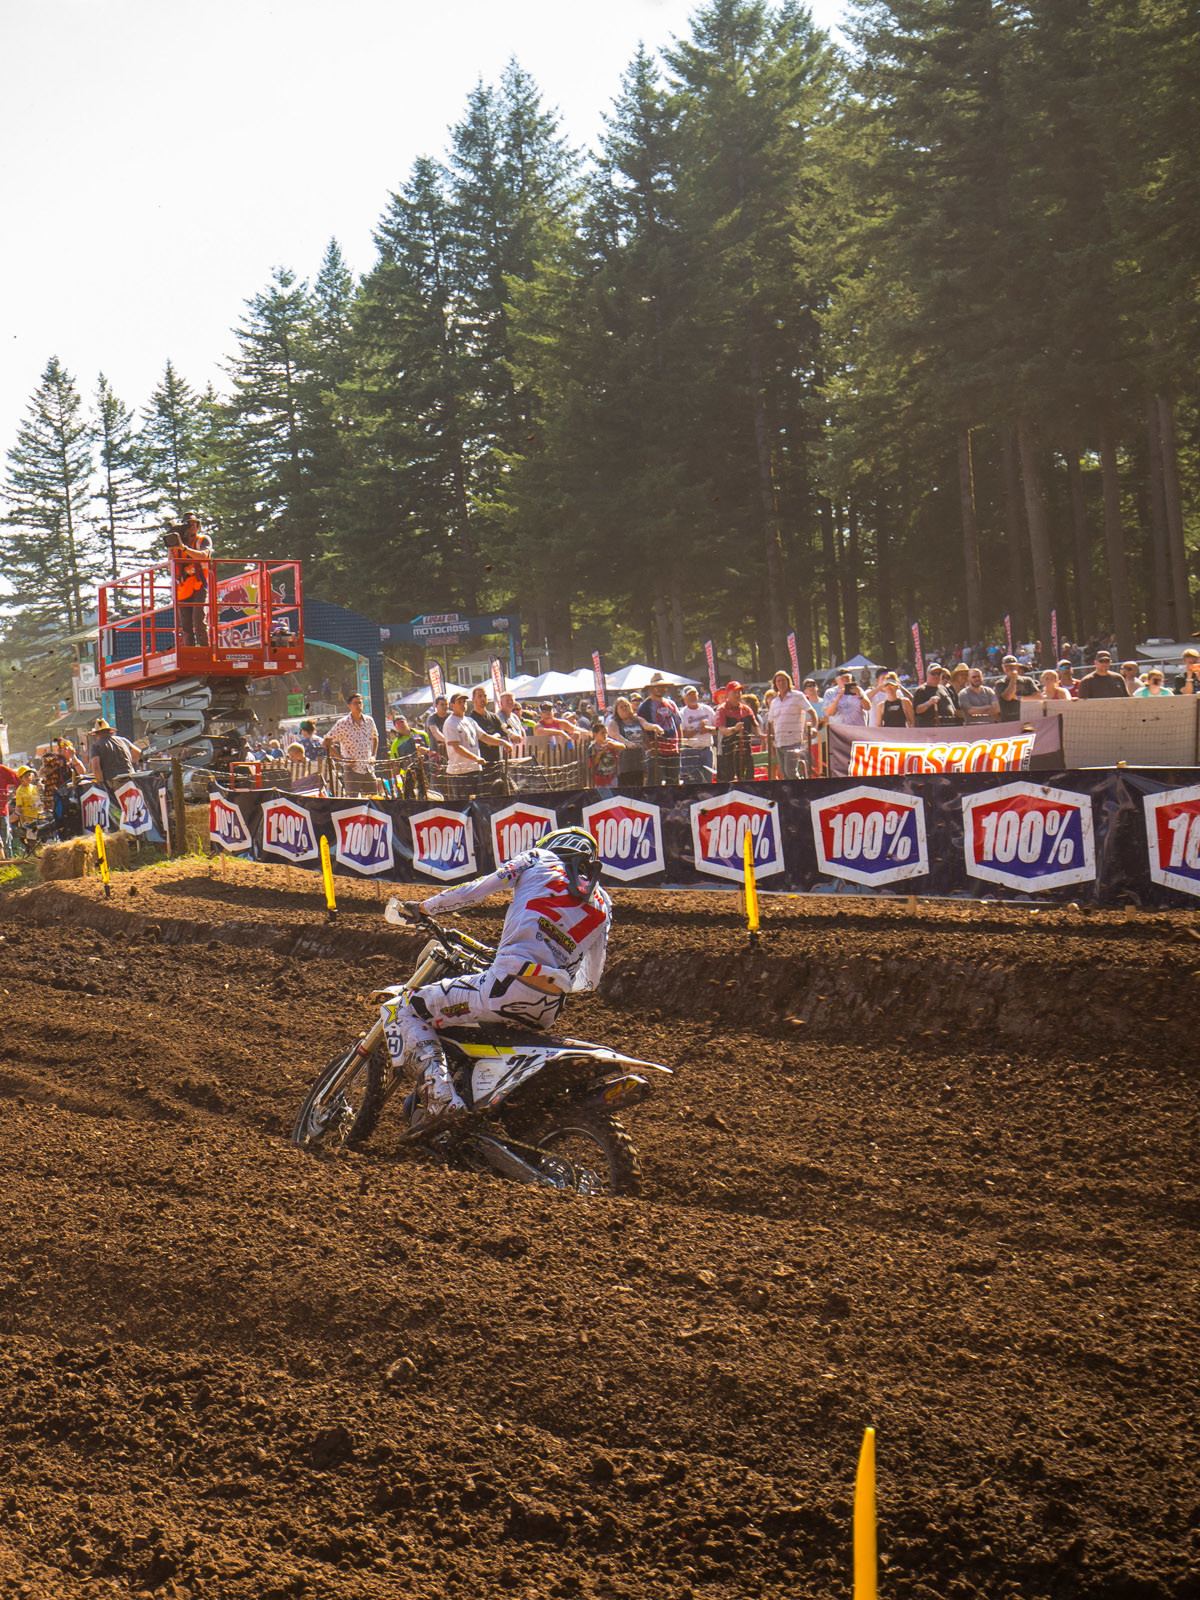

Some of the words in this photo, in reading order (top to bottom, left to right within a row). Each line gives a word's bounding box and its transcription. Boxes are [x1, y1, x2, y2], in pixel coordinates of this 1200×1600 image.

[413, 623, 470, 637] MOTOCROSS
[214, 804, 241, 839] 100%
[269, 812, 308, 848] 100%
[345, 822, 386, 858] 100%
[597, 816, 649, 859] 100%
[706, 813, 769, 859] 100%
[829, 810, 911, 861] 100%
[981, 810, 1074, 865] 100%
[420, 825, 464, 862] 100%
